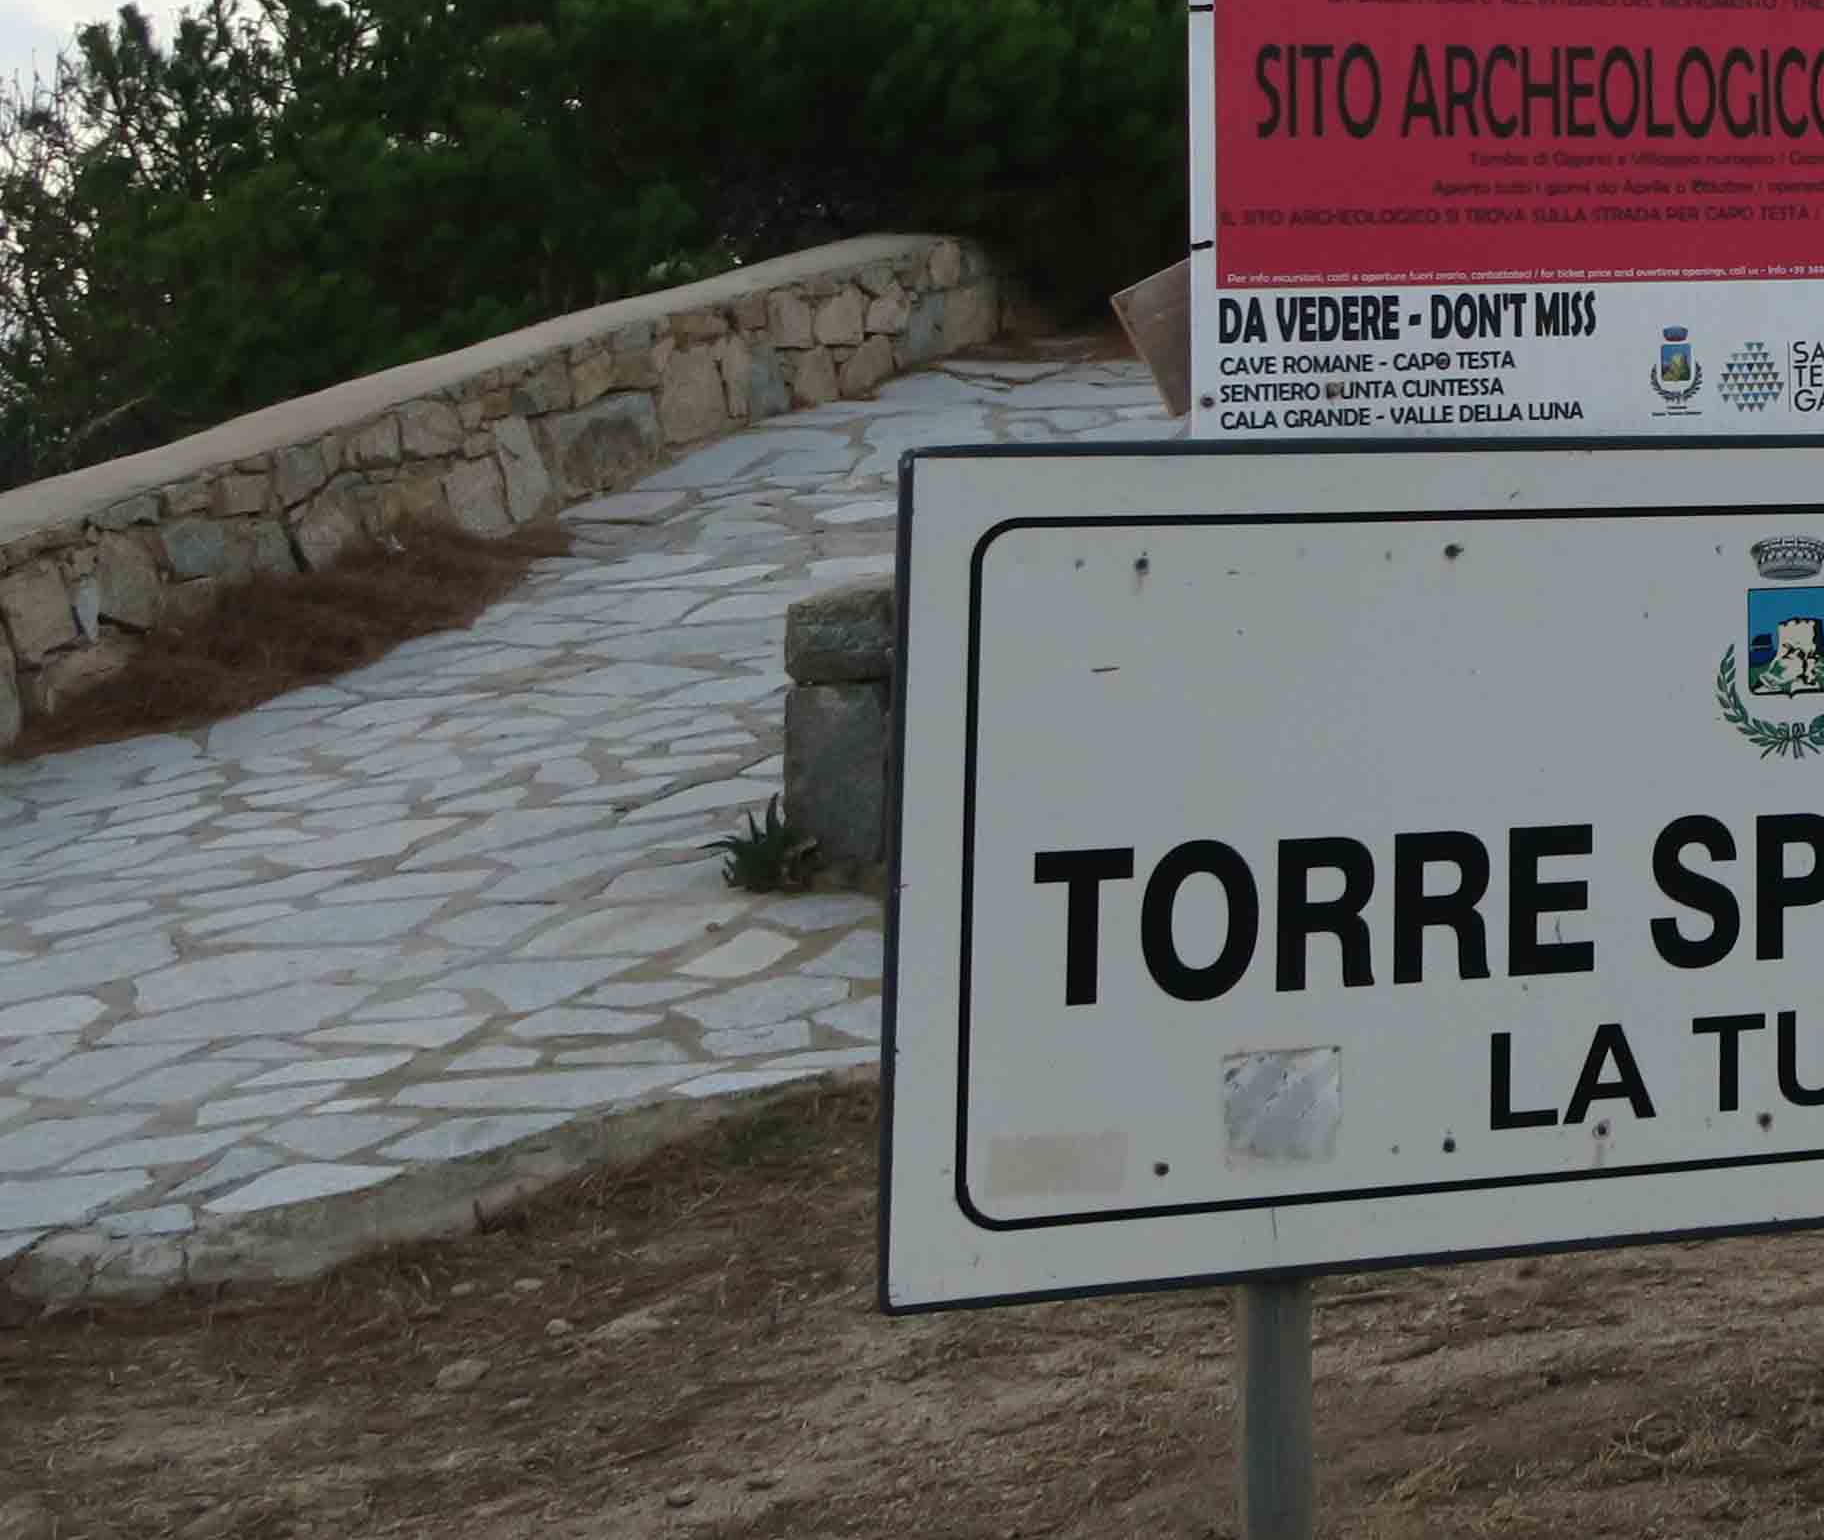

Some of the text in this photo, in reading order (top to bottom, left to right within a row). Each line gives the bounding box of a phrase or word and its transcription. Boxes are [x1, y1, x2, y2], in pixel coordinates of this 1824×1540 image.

[1255, 43, 1383, 140] SITO
[1218, 296, 1267, 345] DA
[1277, 294, 1401, 343] VEDERE
[1431, 291, 1528, 341] DON'T
[1535, 289, 1598, 338] MISS
[1219, 356, 1279, 377] CAVE
[1283, 353, 1374, 375] ROMANE
[1393, 351, 1452, 372] CAPO
[1455, 349, 1516, 371] TESTA
[1220, 381, 1321, 404] SENTIERO
[1402, 376, 1505, 399] CUNTESSA
[1219, 410, 1279, 432] CALA
[1283, 407, 1372, 430] GRANDE
[1389, 405, 1455, 426] VALLE
[1458, 403, 1523, 424] DELLA
[1528, 400, 1584, 422] LUNA
[1034, 823, 1596, 1010] TORRE
[1488, 1021, 1655, 1135] LA
